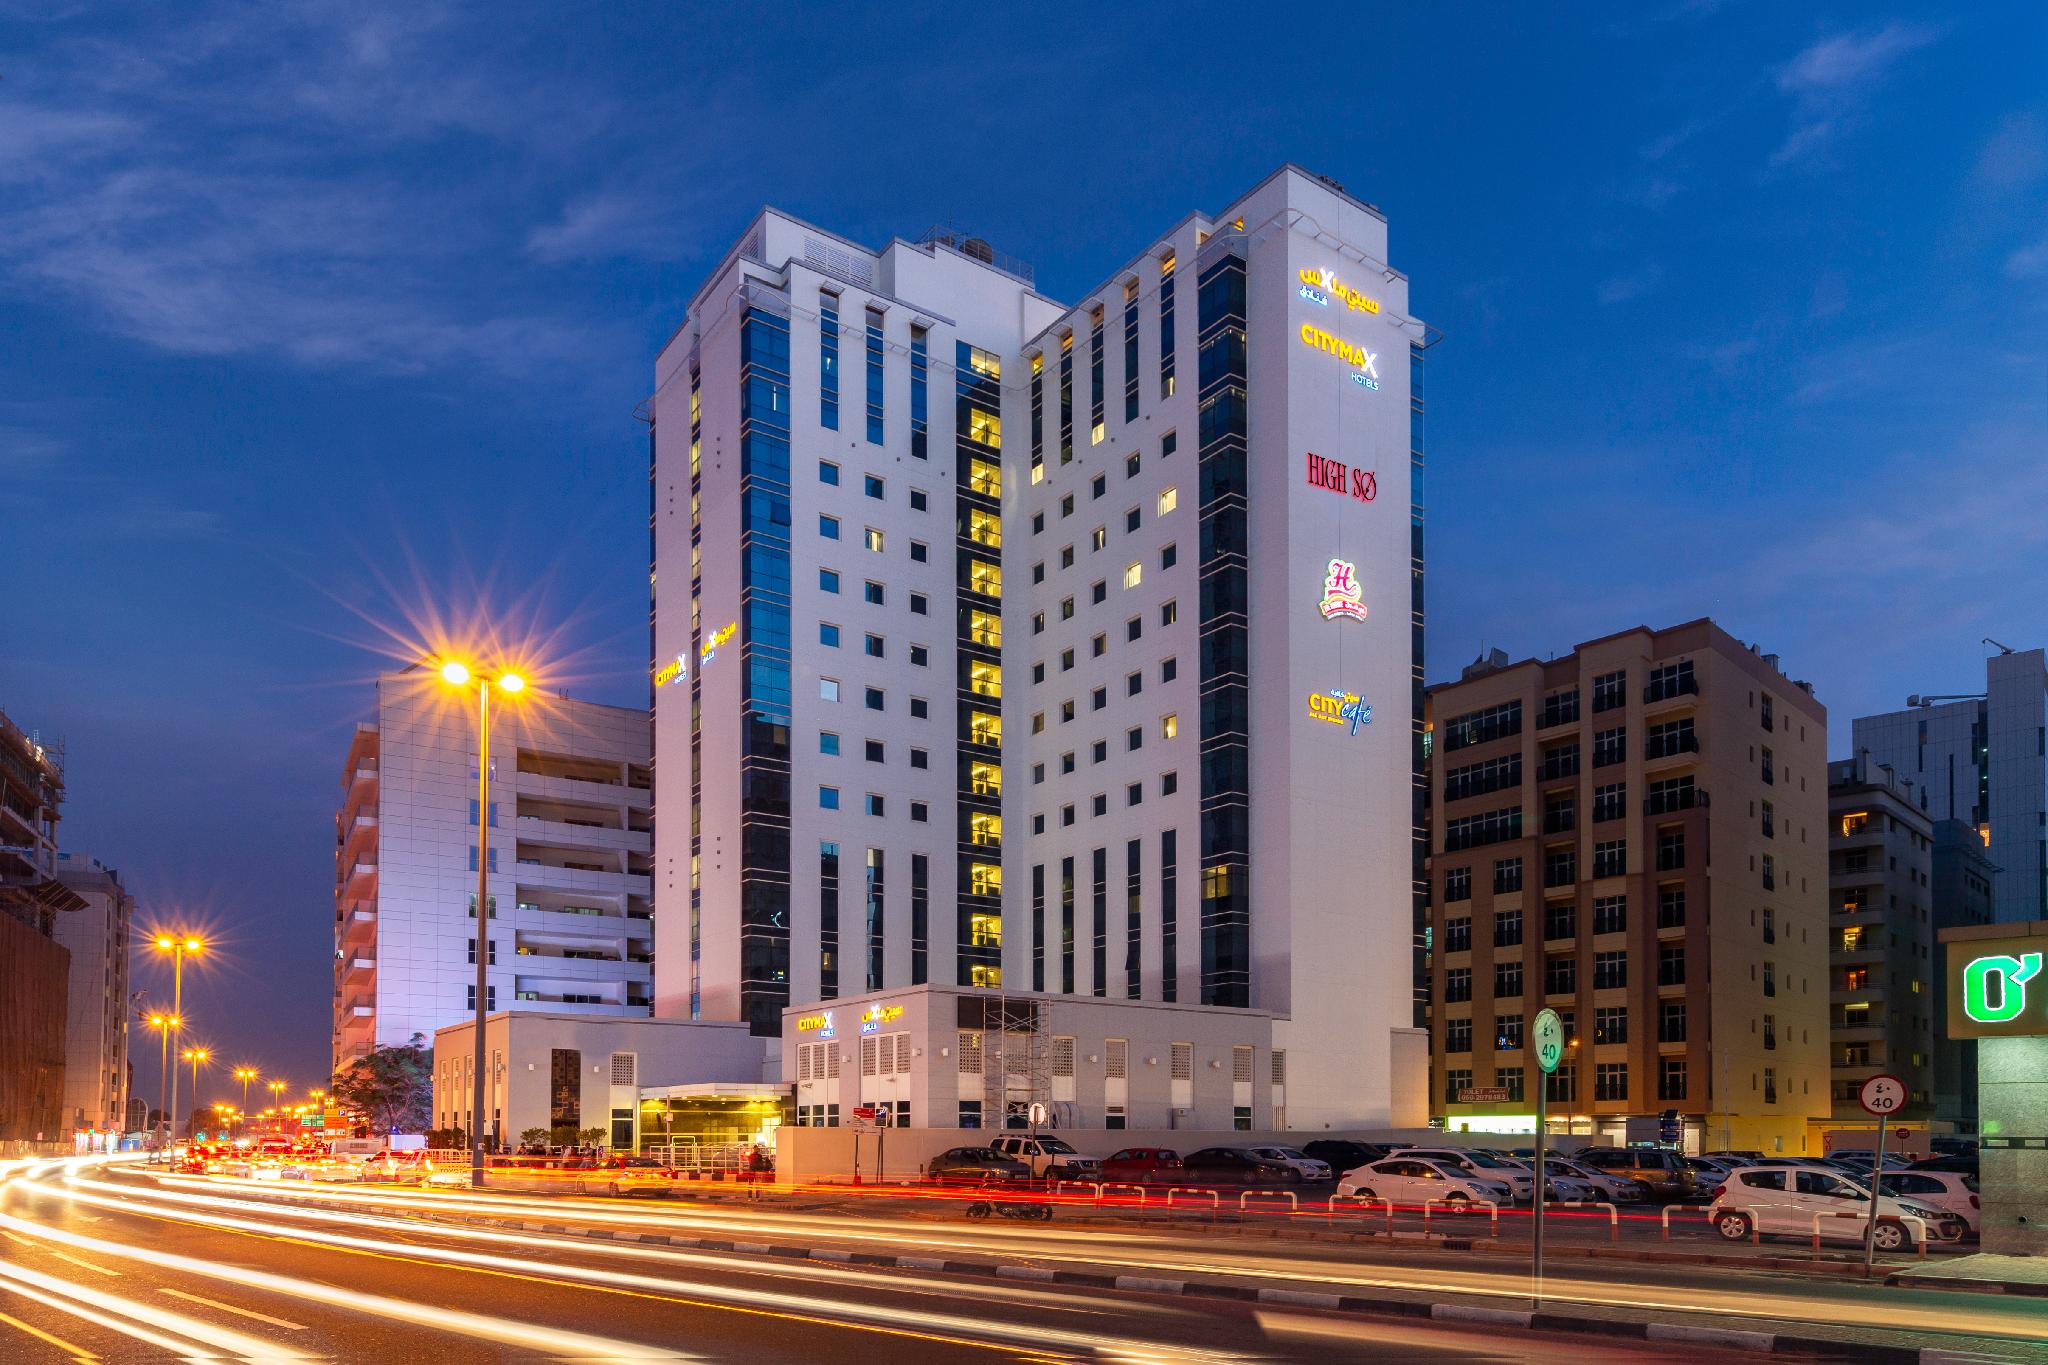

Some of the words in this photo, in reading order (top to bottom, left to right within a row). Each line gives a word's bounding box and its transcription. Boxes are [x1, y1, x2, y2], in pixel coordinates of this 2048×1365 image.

[1301, 323, 1378, 379] CITYMAX
[1351, 371, 1379, 391] HOTELS
[1307, 452, 1348, 494] HIGH
[1309, 693, 1343, 716] CITY
[799, 1011, 833, 1031] CITYMAX
[1542, 1044, 1556, 1060] 40
[1871, 1098, 1893, 1108] 40
